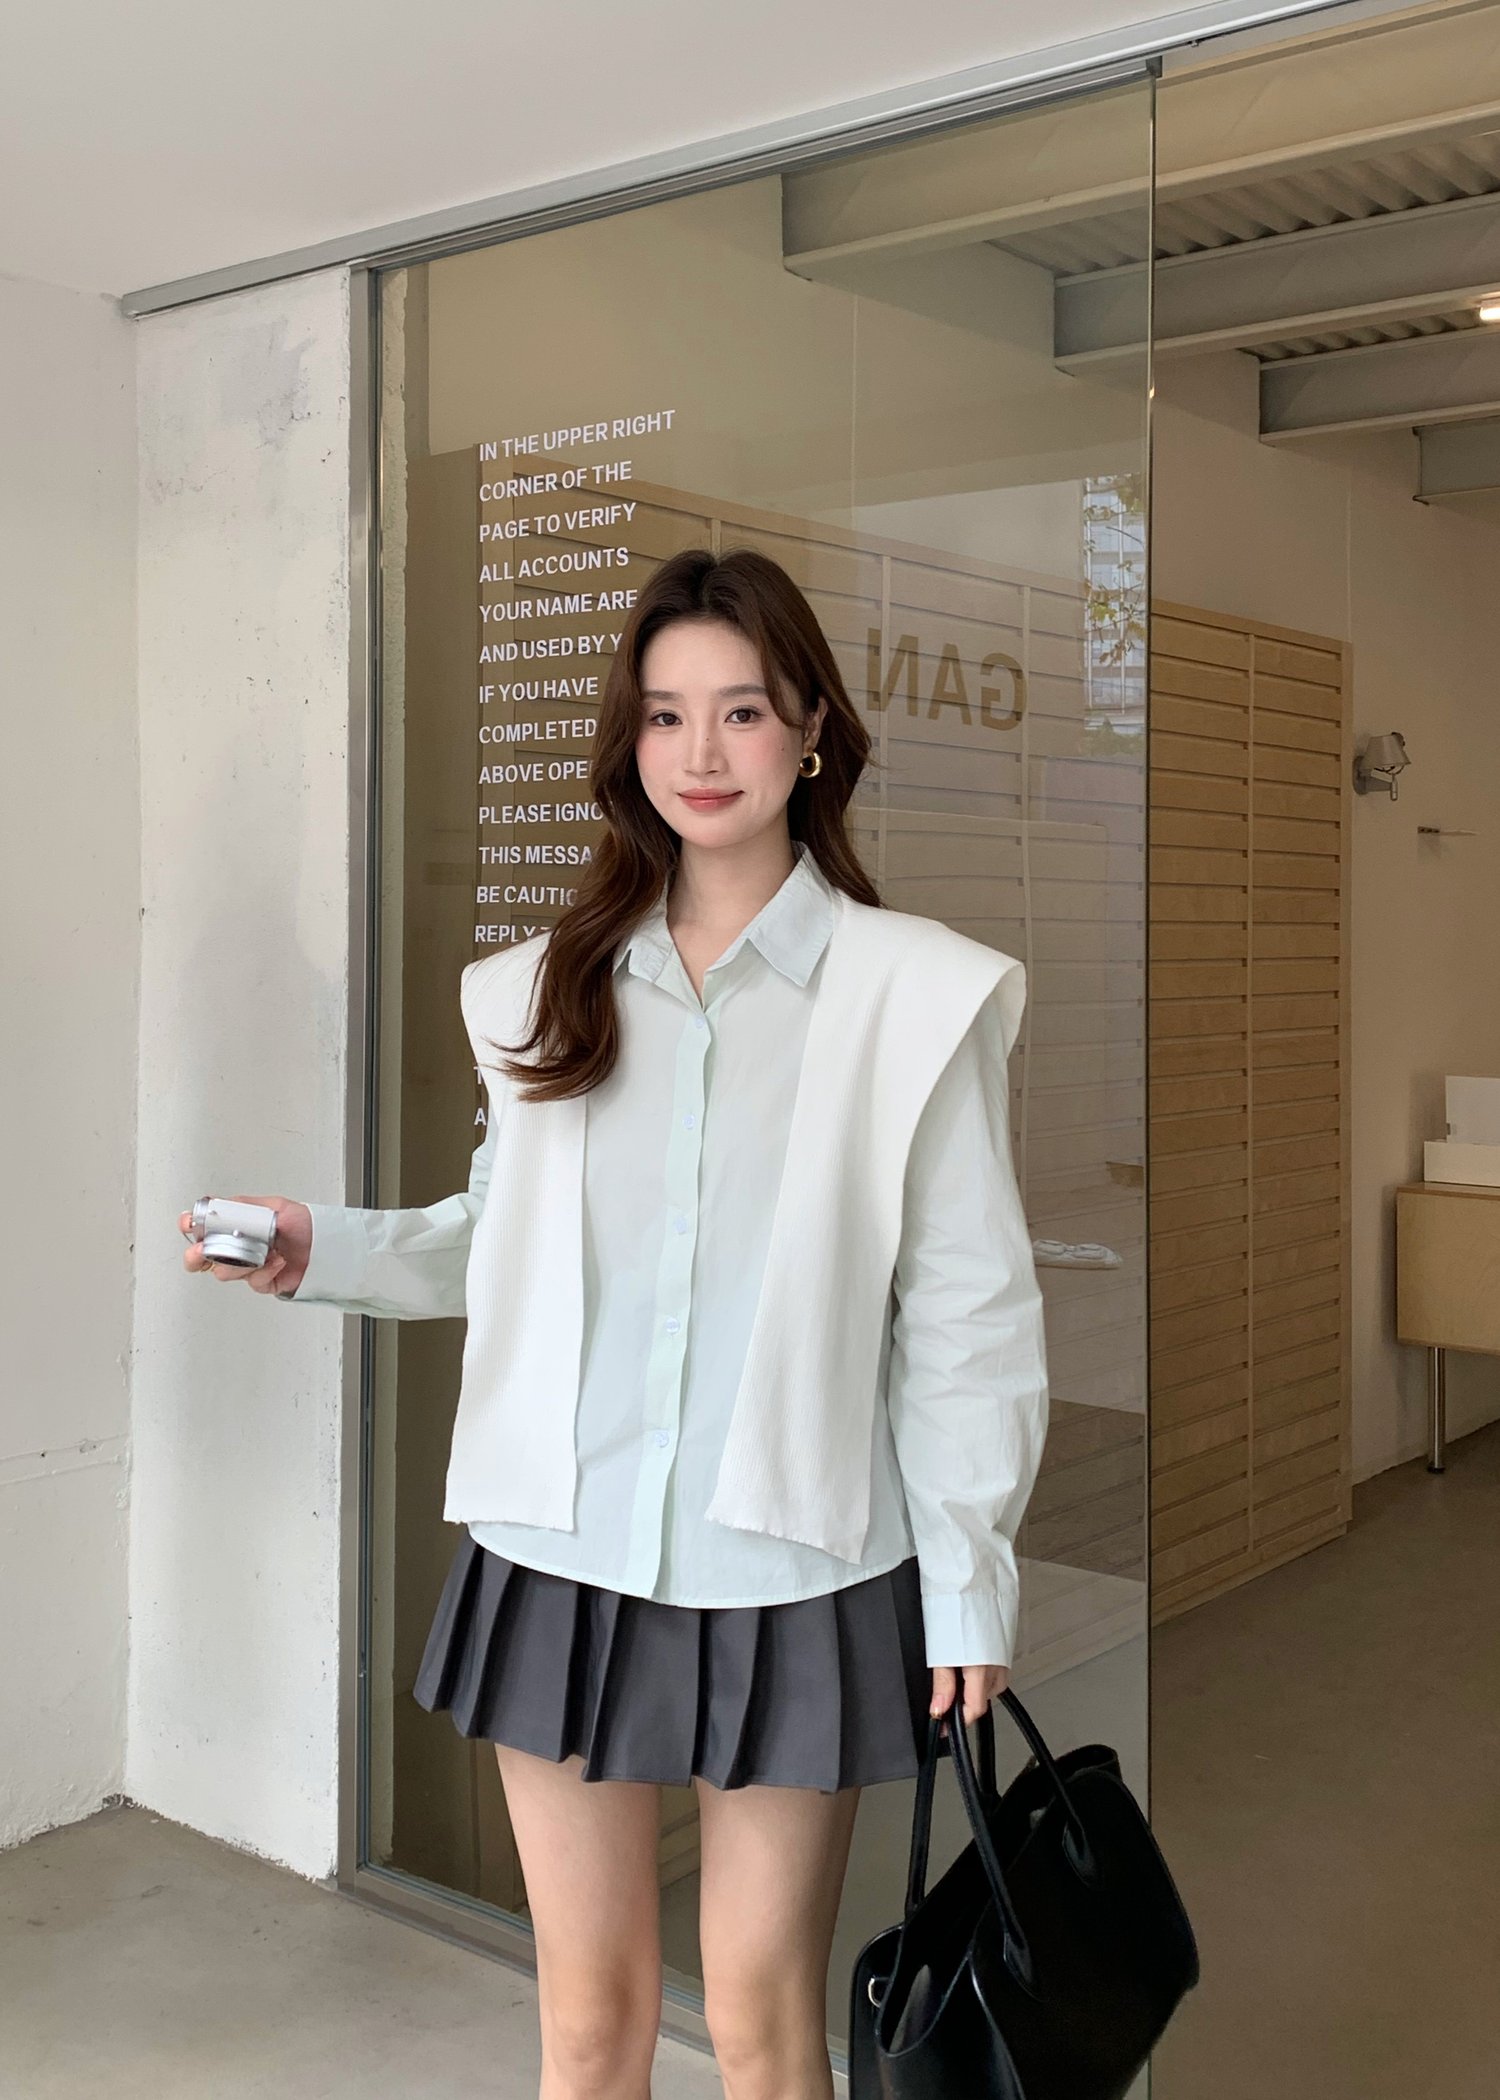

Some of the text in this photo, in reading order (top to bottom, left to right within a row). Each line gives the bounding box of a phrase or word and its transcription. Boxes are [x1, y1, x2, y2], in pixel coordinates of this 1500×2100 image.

[480, 409, 676, 462] IN THE UPPER RIGHT
[479, 461, 632, 503] CORNER OF THE
[479, 502, 637, 542] PAGE TO VERIFY
[479, 547, 630, 583] ALL ACCOUNTS
[479, 589, 638, 623] YOUR NAME ARE
[479, 642, 519, 664] AND
[522, 636, 574, 659] USED
[578, 634, 606, 654] BY
[479, 676, 599, 703] IF YOU HAVE
[479, 718, 598, 744] COMPLETED
[478, 763, 544, 784] ABOVE
[479, 804, 551, 825] PLEASE
[479, 846, 522, 865] THIS
[476, 886, 501, 904] BE
